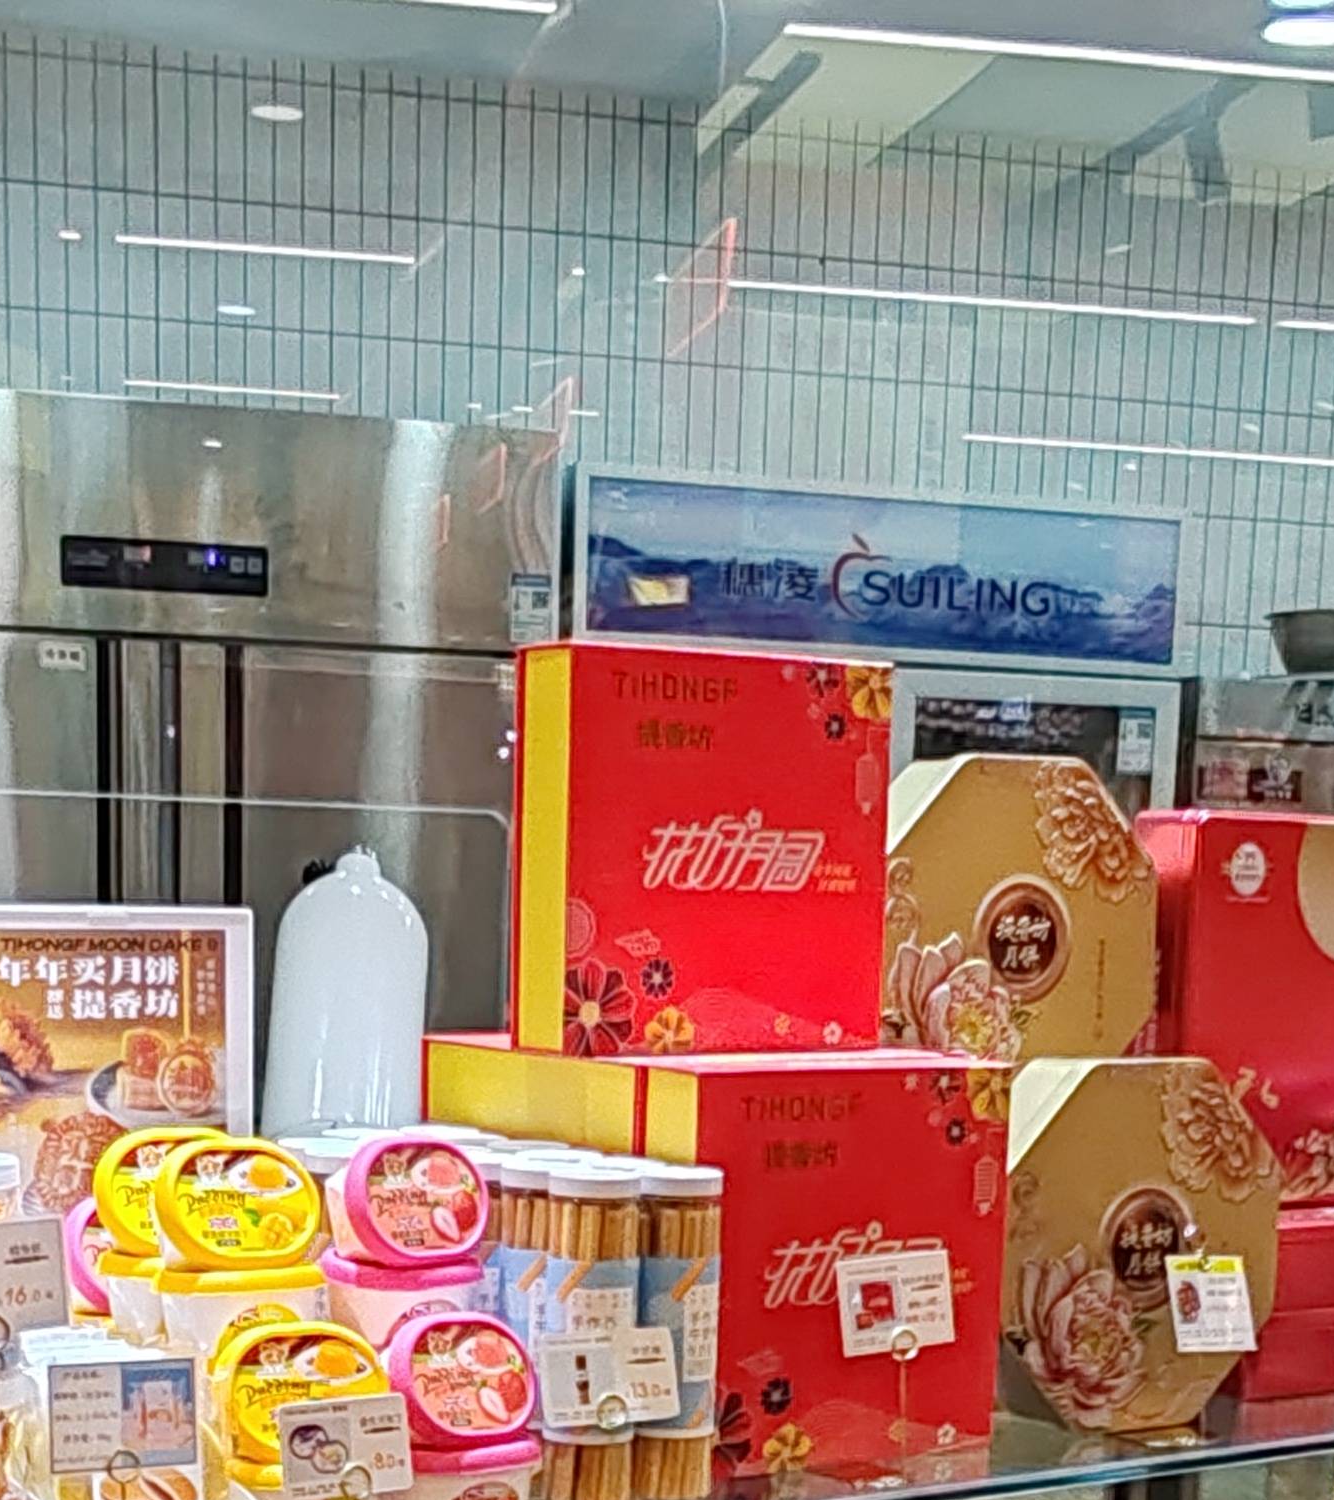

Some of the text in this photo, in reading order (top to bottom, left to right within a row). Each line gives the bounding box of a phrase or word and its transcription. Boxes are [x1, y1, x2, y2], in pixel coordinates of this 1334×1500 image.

[860, 570, 1053, 617] SUILING
[611, 670, 739, 704] TIHONGF
[643, 808, 826, 892] 花好月圆
[0, 936, 202, 951] TIHONGF MOON CAKE
[71, 988, 180, 1020] 提香坊
